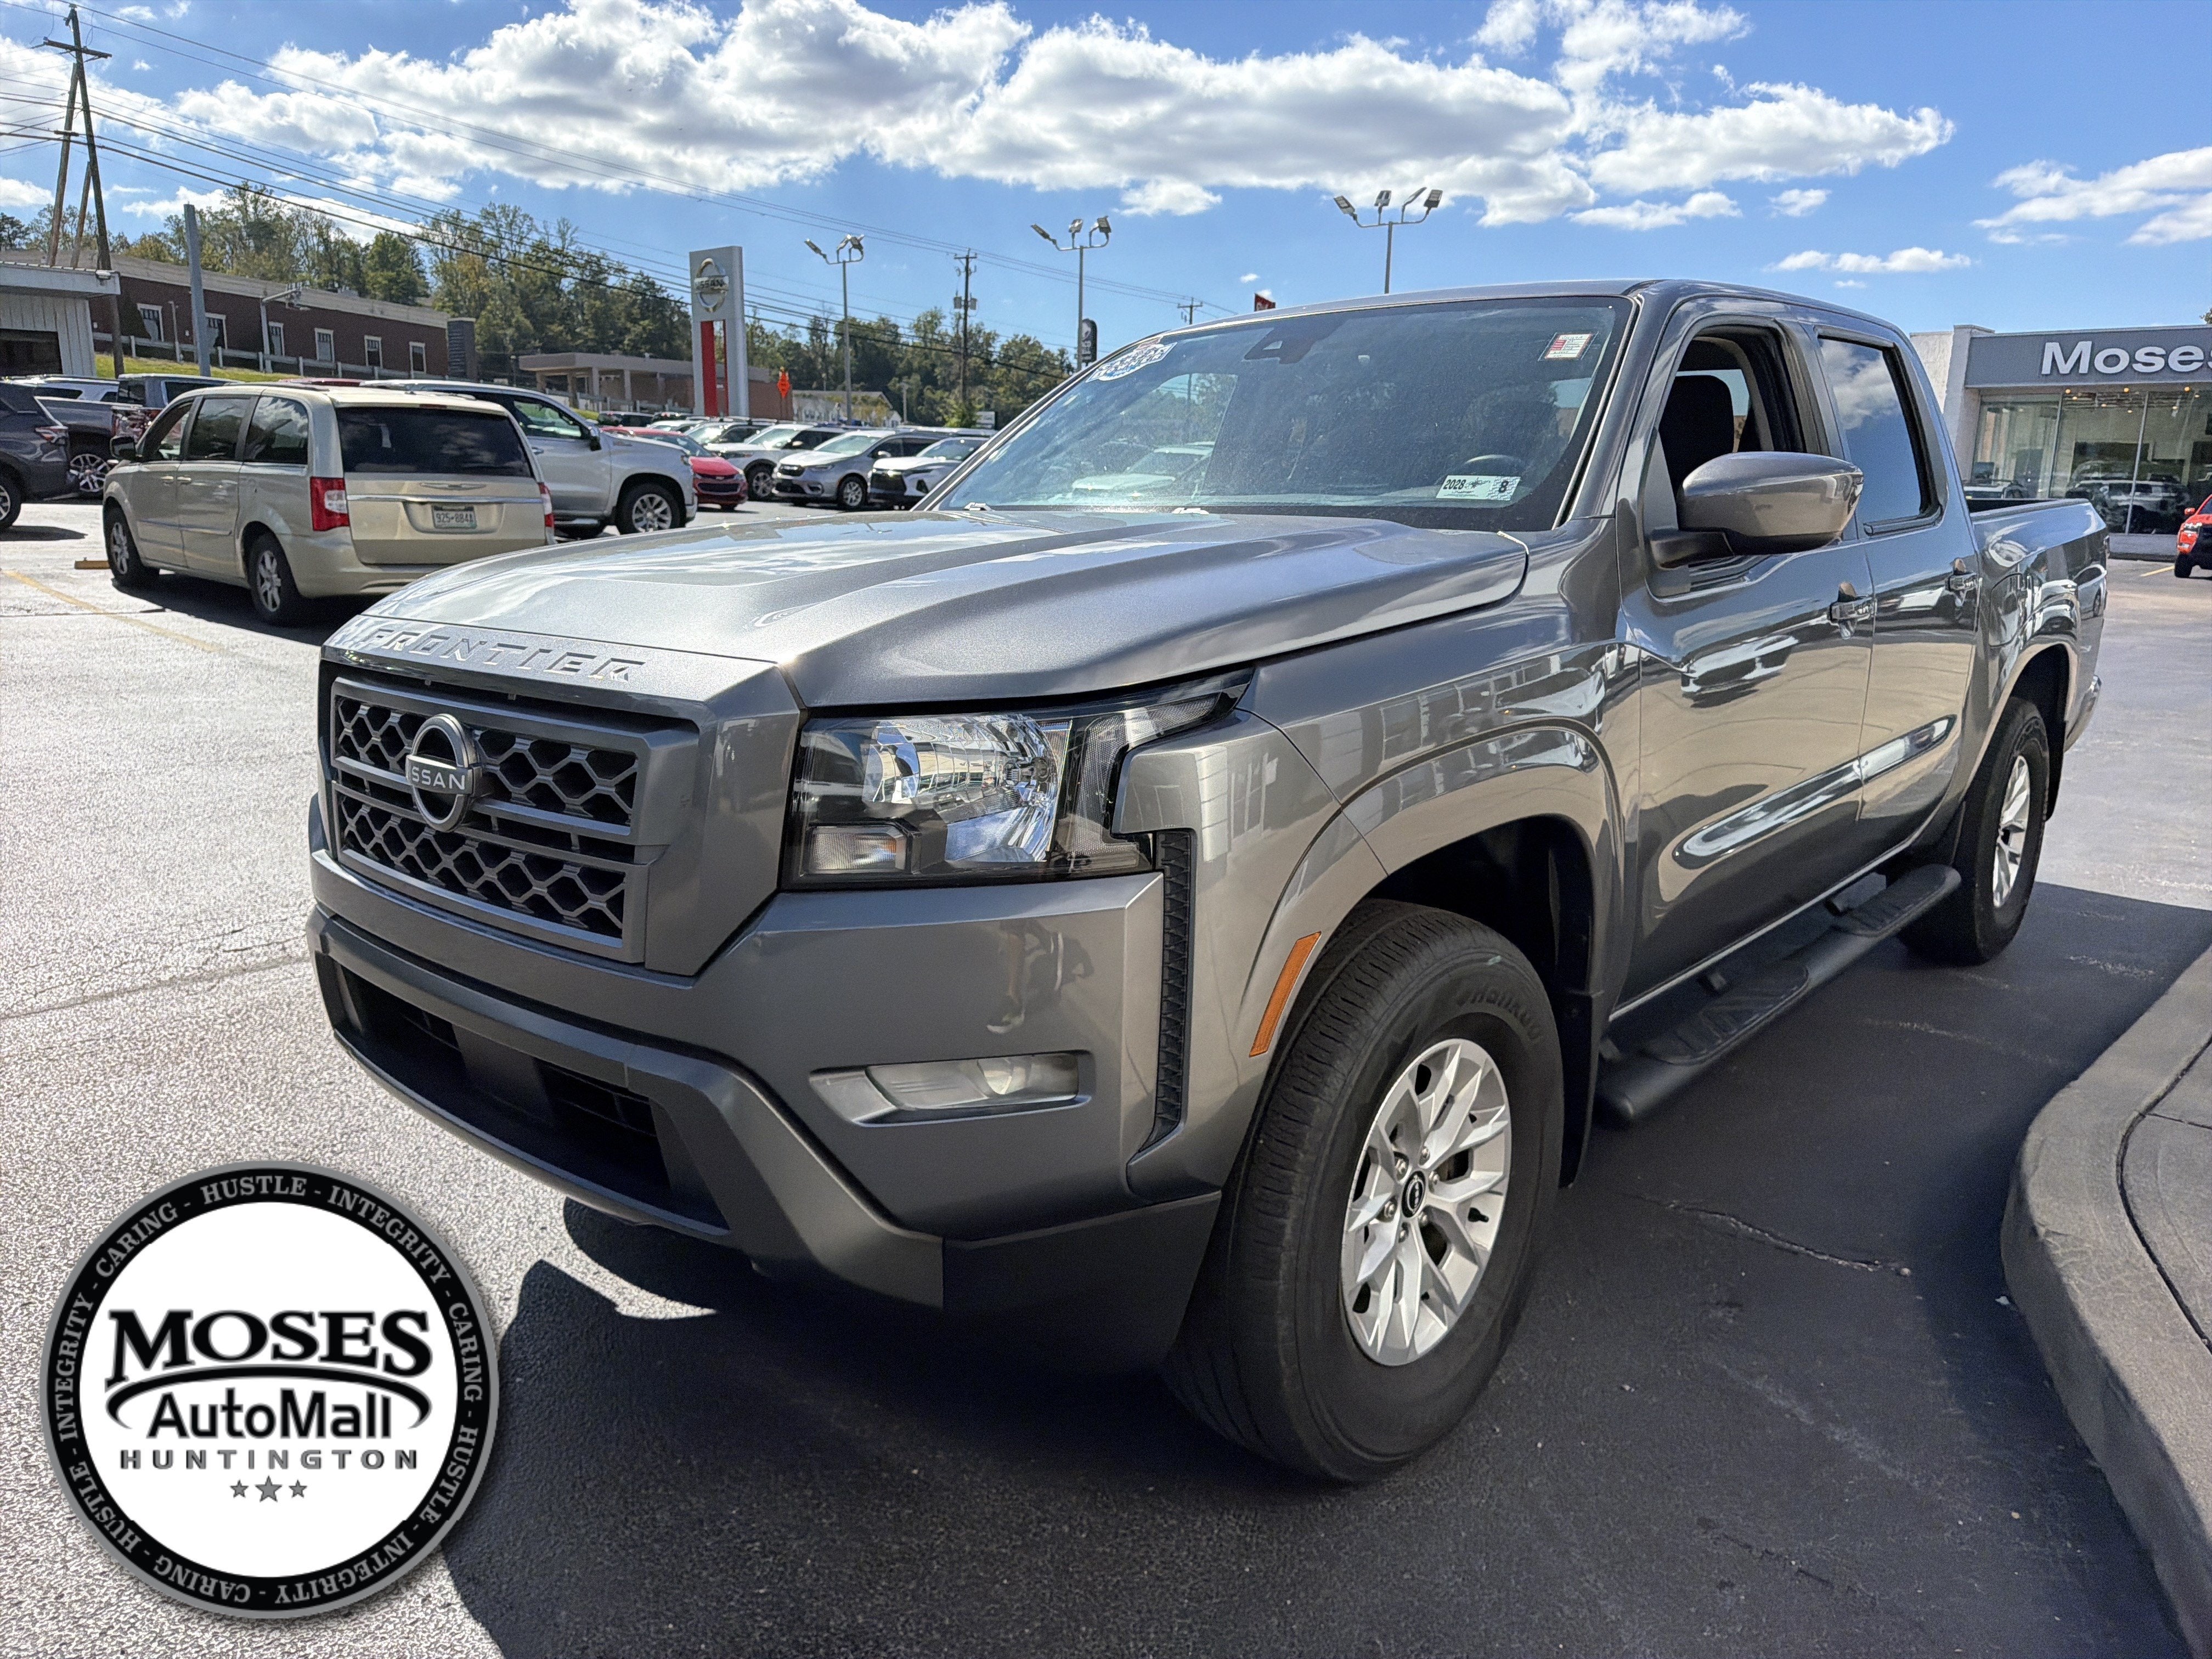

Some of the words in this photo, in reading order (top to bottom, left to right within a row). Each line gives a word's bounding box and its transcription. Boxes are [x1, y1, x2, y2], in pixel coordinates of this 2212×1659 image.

[2041, 341, 2212, 374] Mose
[1442, 479, 1467, 490] 2028
[1498, 480, 1509, 493] 8
[360, 628, 646, 682] FRONTIER
